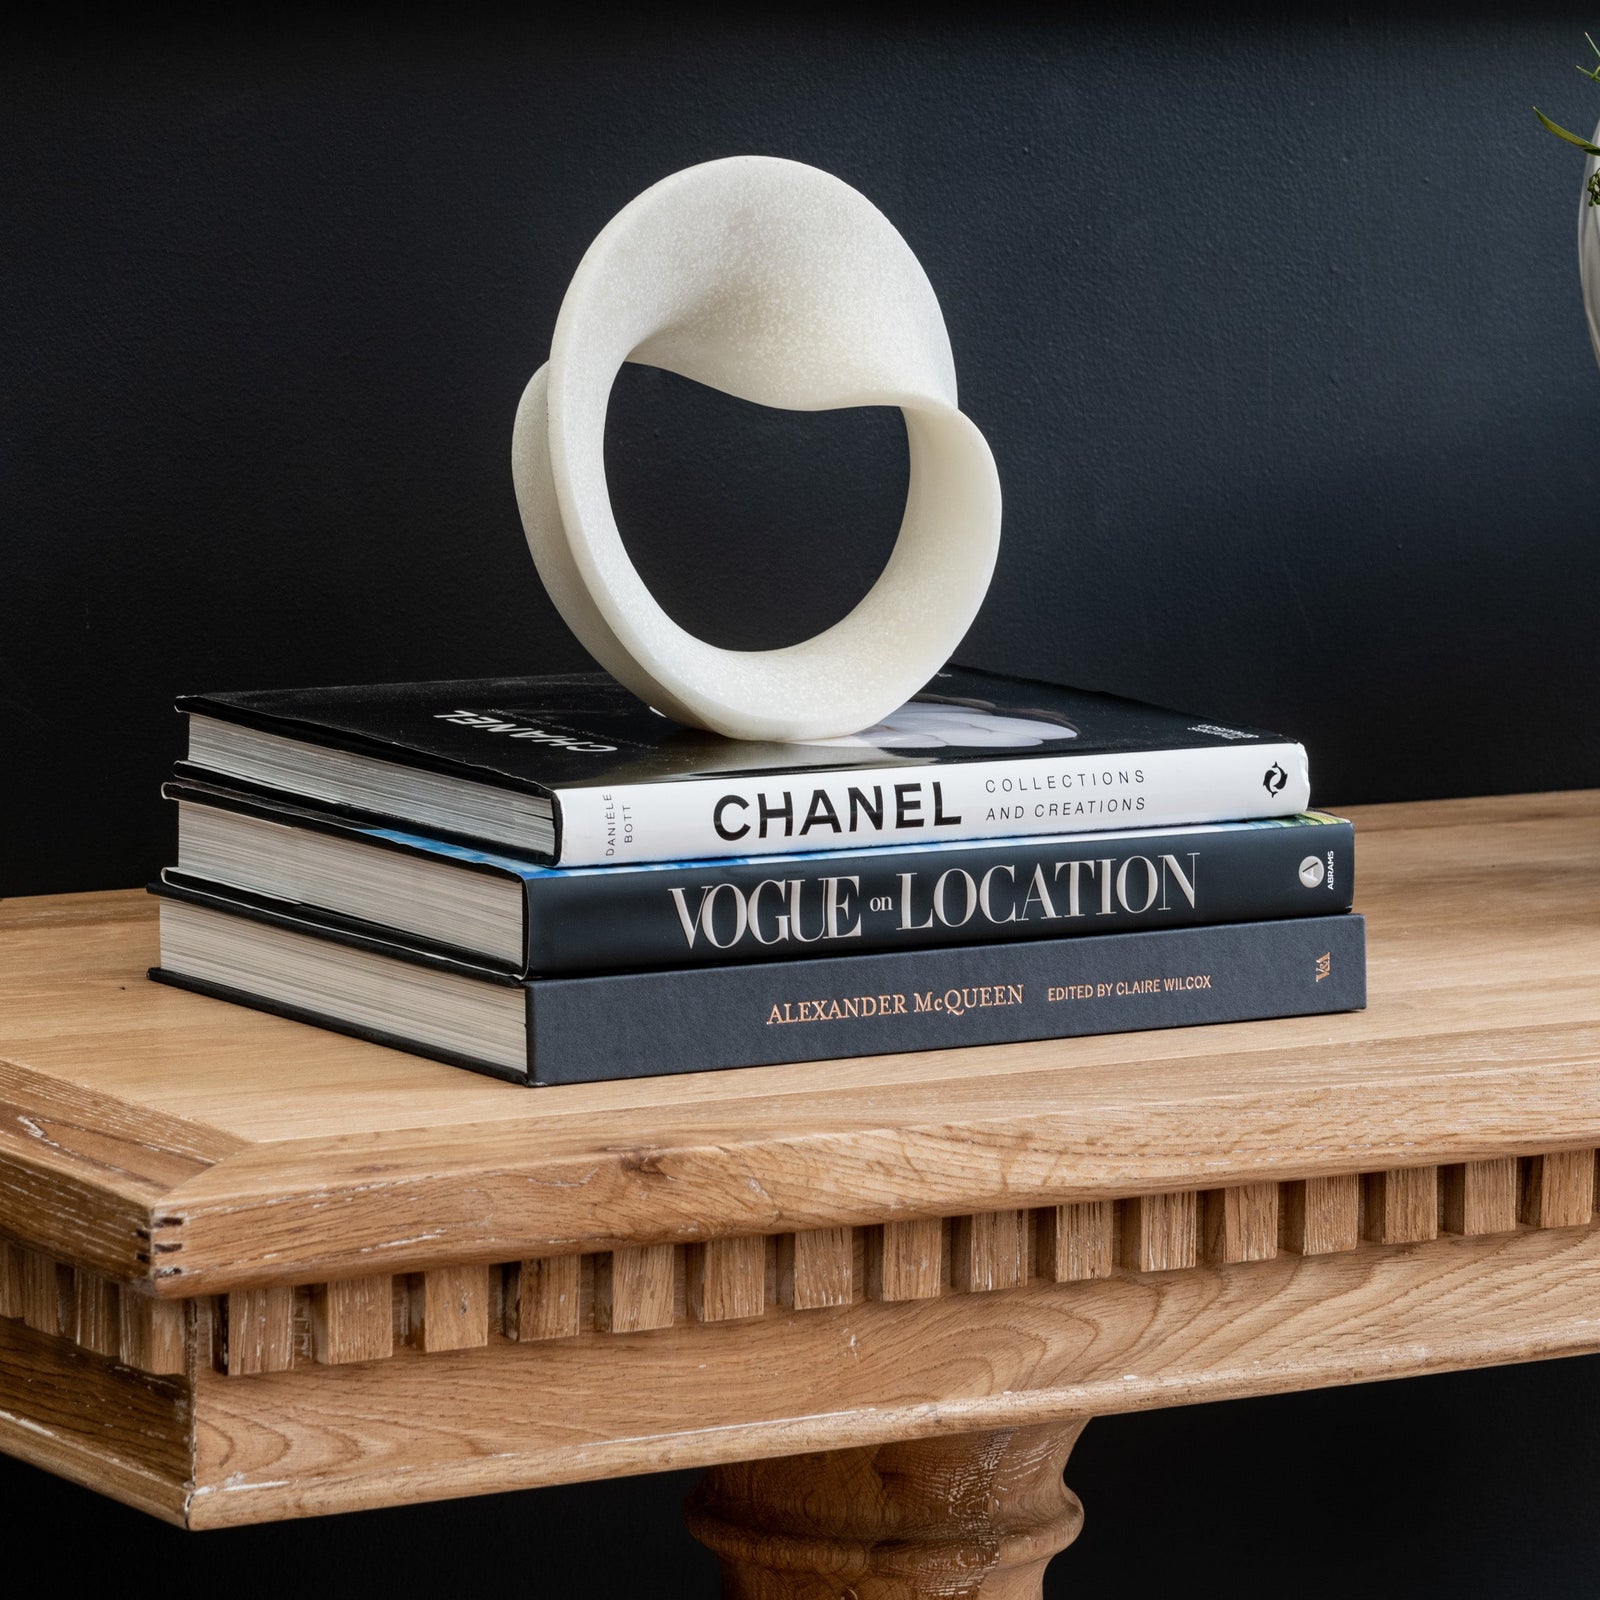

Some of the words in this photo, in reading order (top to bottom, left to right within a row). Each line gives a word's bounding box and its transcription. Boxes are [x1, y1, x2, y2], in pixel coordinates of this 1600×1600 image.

[434, 709, 618, 752] CHANEL
[985, 769, 1145, 793] COLLECTIONS
[622, 804, 634, 844] BOTT
[713, 781, 962, 842] CHANEL
[985, 805, 1025, 821] AND
[1034, 797, 1145, 818] CREATIONS
[1327, 850, 1335, 890] ABRAMS
[667, 875, 862, 949] VOGUE
[869, 895, 893, 912] on
[896, 852, 1200, 931] LOCATION
[1315, 952, 1331, 982] V&A
[766, 993, 908, 1025] ALEXANDER
[913, 984, 1025, 1016] McQUEEN
[1048, 984, 1094, 1002] EDITED
[1097, 982, 1113, 998] BY
[1116, 979, 1161, 996] CLAIRE
[1164, 975, 1212, 992] WILCOX
